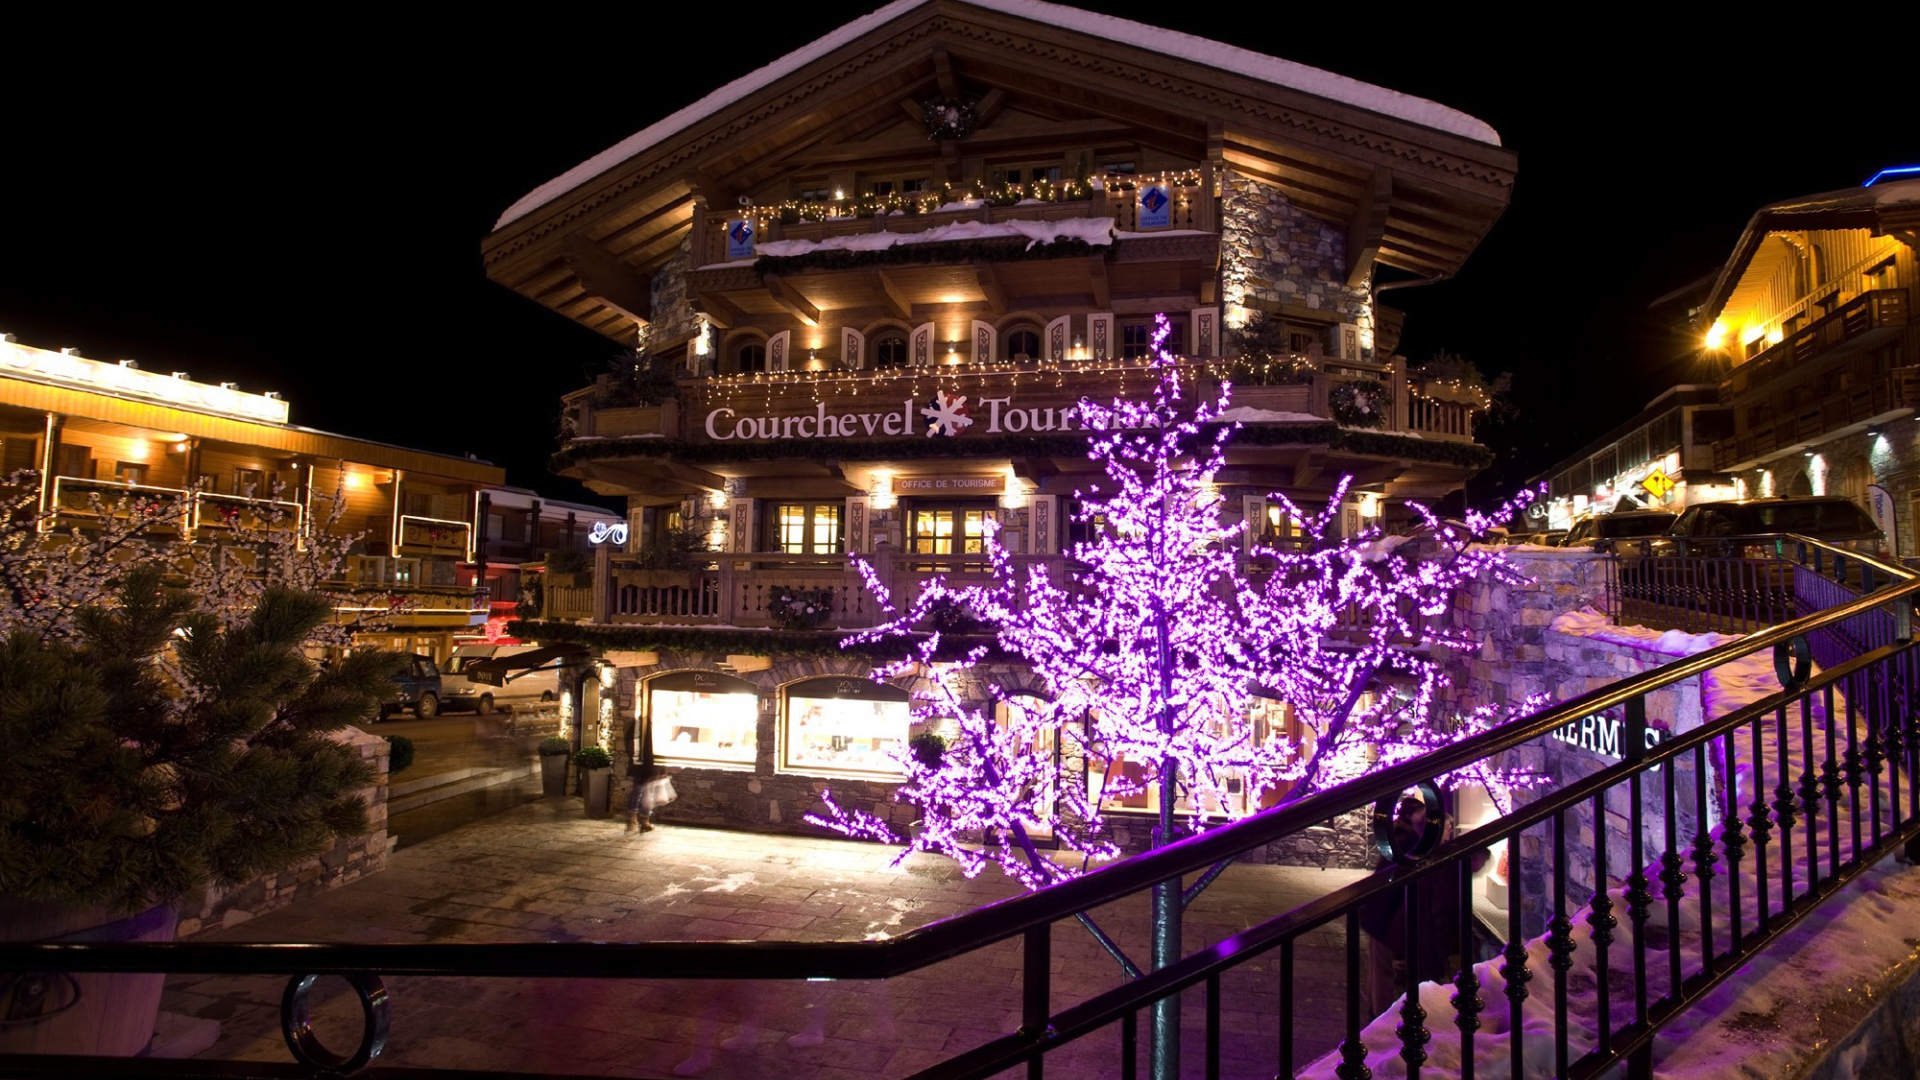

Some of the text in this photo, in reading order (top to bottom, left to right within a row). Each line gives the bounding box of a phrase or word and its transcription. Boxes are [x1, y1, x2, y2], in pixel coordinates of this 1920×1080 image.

[705, 398, 915, 441] Courchevel
[901, 478, 997, 489] OFFICE DE TOURISME
[1552, 715, 1660, 772] ERMS
